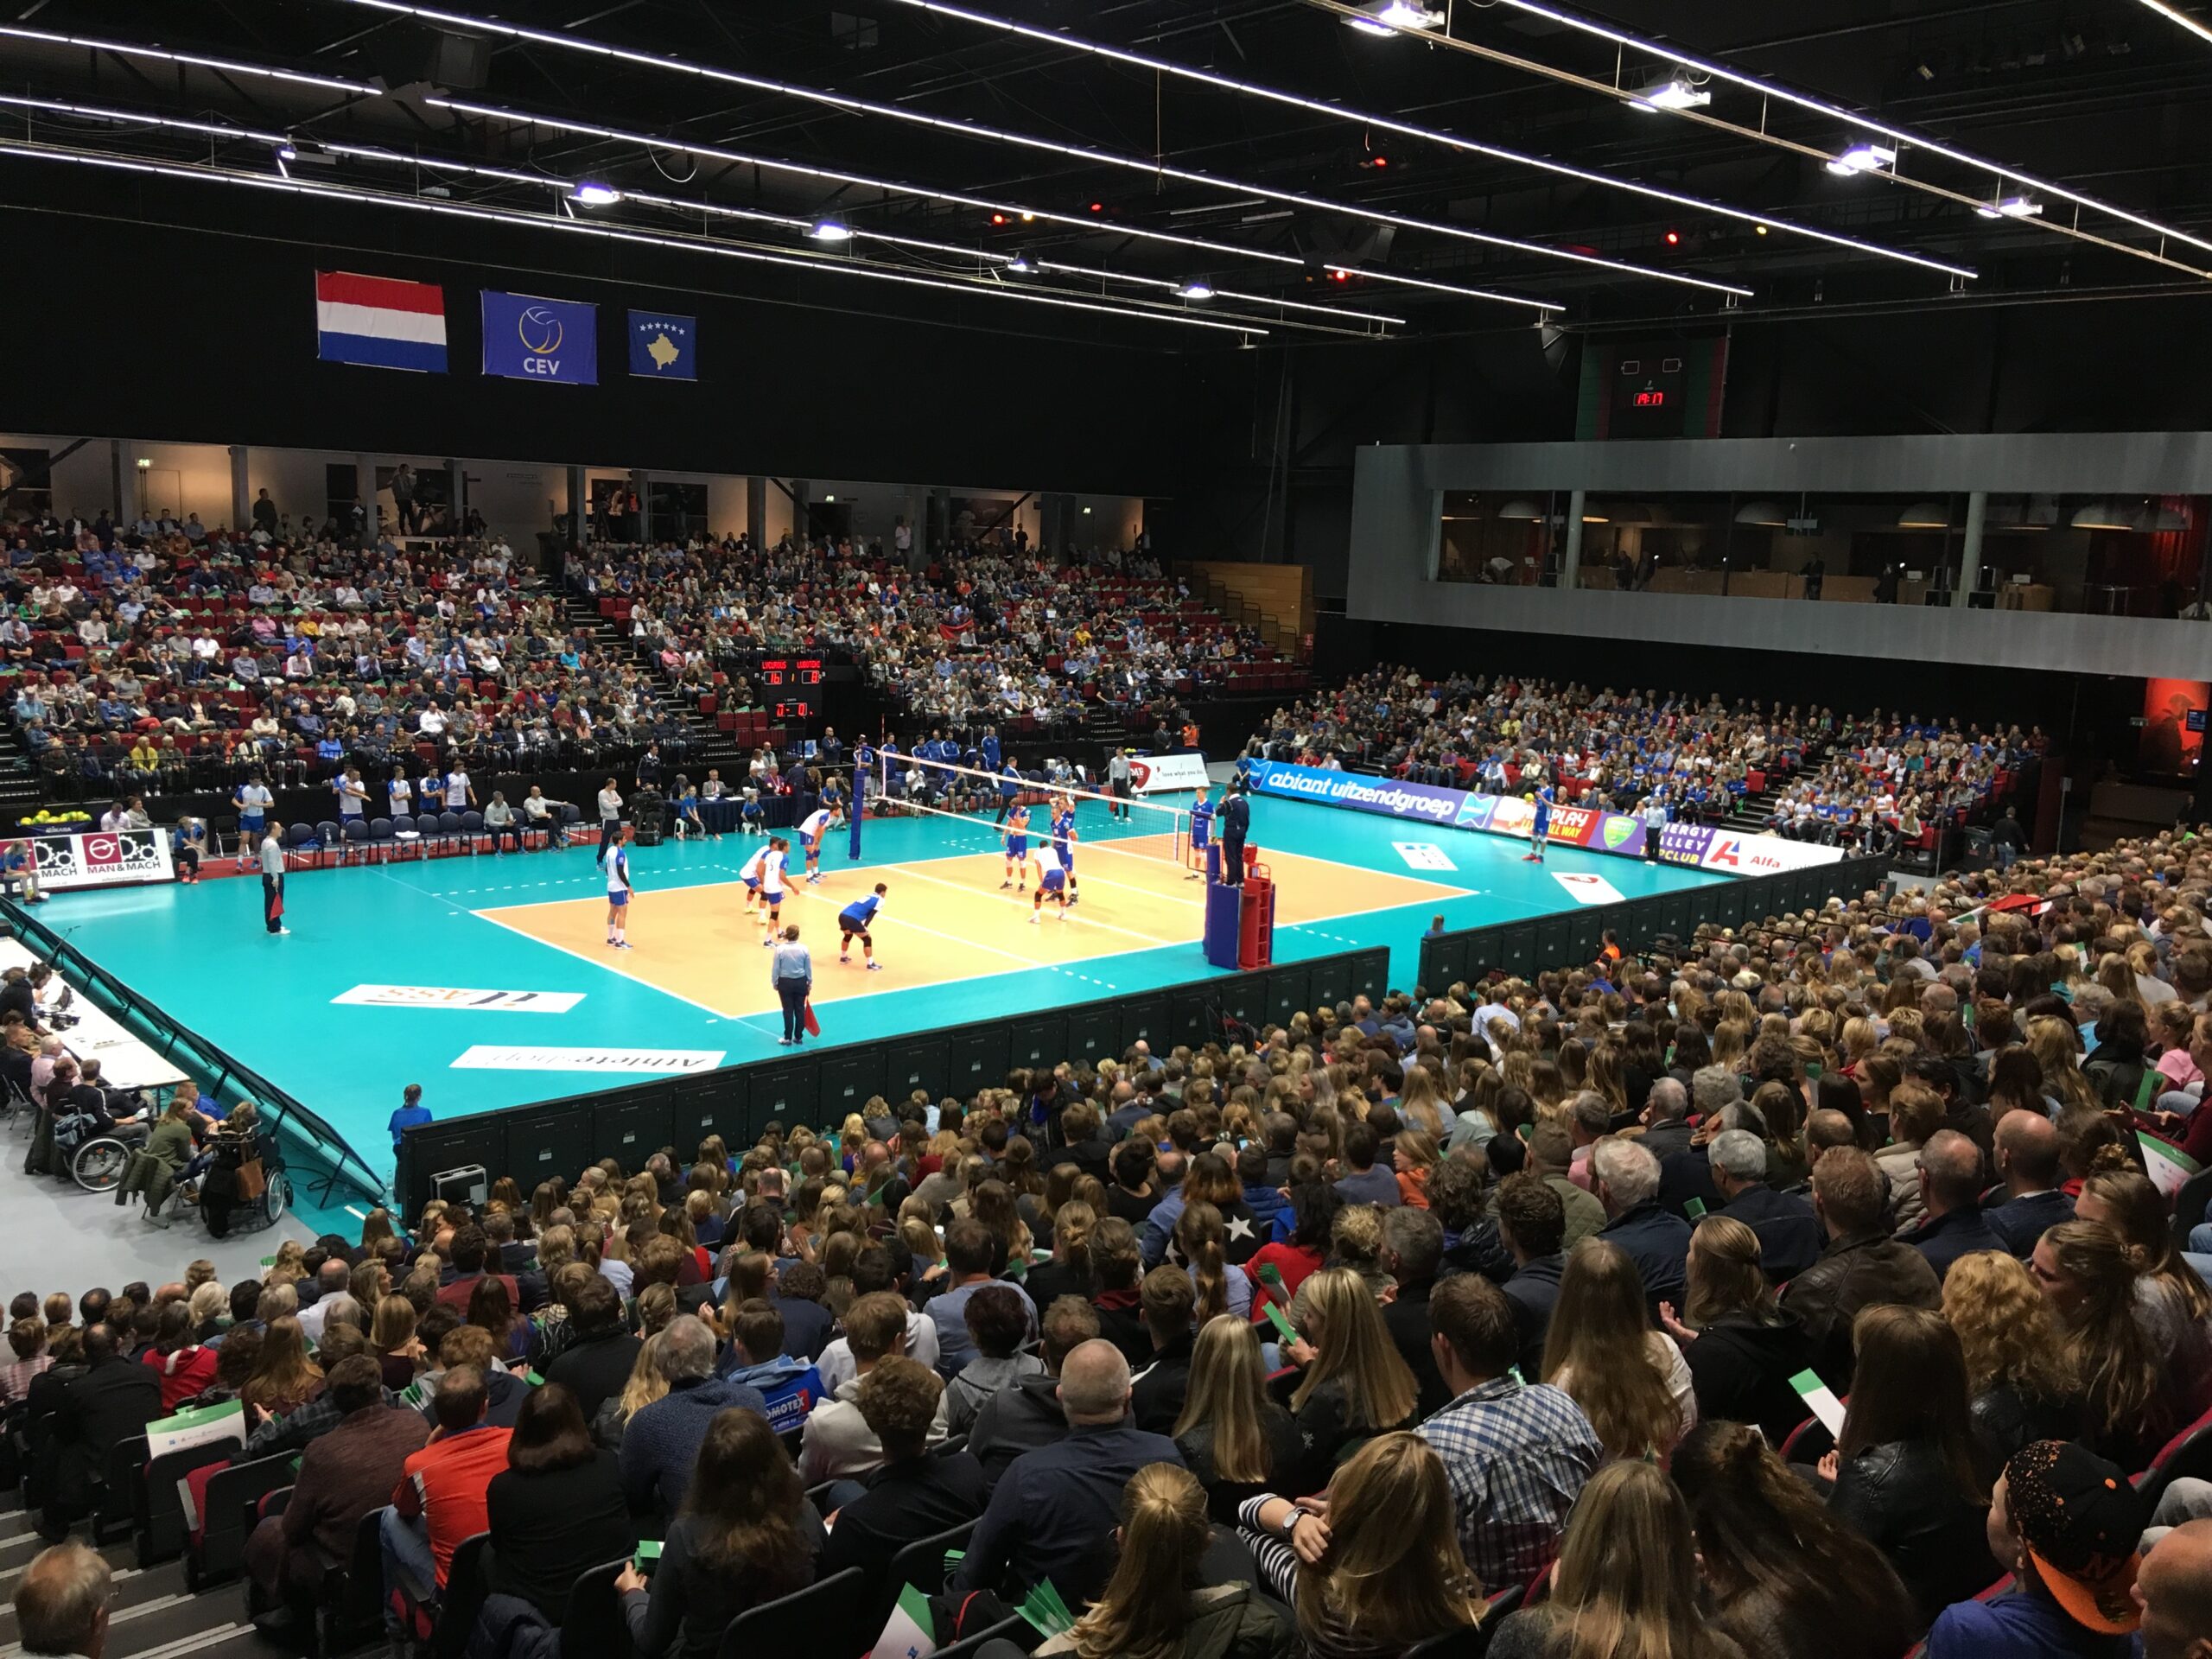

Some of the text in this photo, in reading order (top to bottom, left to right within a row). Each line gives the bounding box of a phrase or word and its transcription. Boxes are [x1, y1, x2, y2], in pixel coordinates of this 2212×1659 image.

[523, 357, 561, 376] CEV
[771, 672, 780, 683] 16
[1268, 770, 1455, 819] abiant uitzendgroep
[1550, 809, 1589, 827] PLAY
[1561, 825, 1582, 838] WAY
[86, 861, 161, 874] MAN & MACH
[1750, 855, 1781, 868] Alfa
[41, 868, 78, 878] MACH
